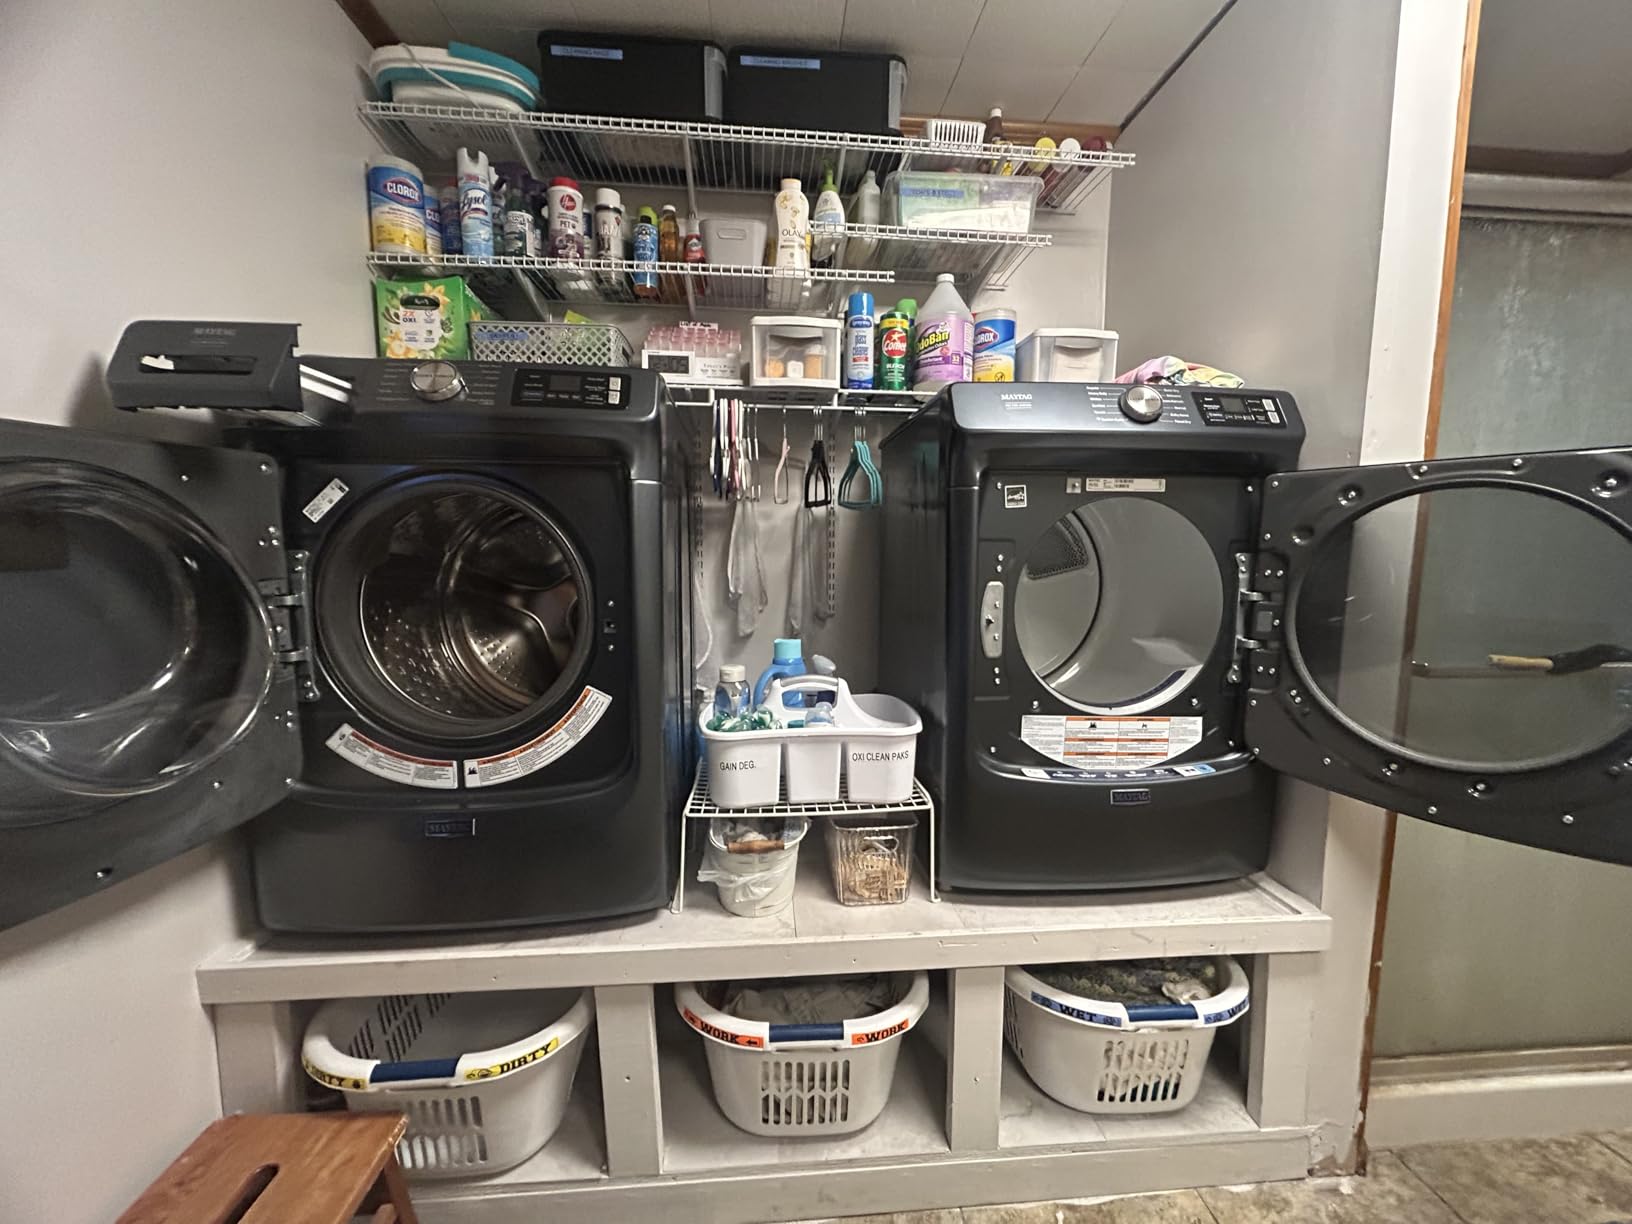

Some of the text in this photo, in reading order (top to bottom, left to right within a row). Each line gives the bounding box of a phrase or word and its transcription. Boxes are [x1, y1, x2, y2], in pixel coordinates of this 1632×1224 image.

[386, 181, 419, 201] CLOROX
[560, 220, 571, 229] PET
[781, 228, 802, 237] OLAY
[1000, 393, 1033, 401] MAYTAG
[852, 750, 909, 762] OXI CLEAN PAKS
[719, 760, 757, 772] GAIN DEG.
[1058, 1004, 1097, 1023] WET
[700, 1020, 739, 1045] WORK
[865, 1020, 906, 1044] WORK
[499, 1042, 553, 1076] DIRTY
